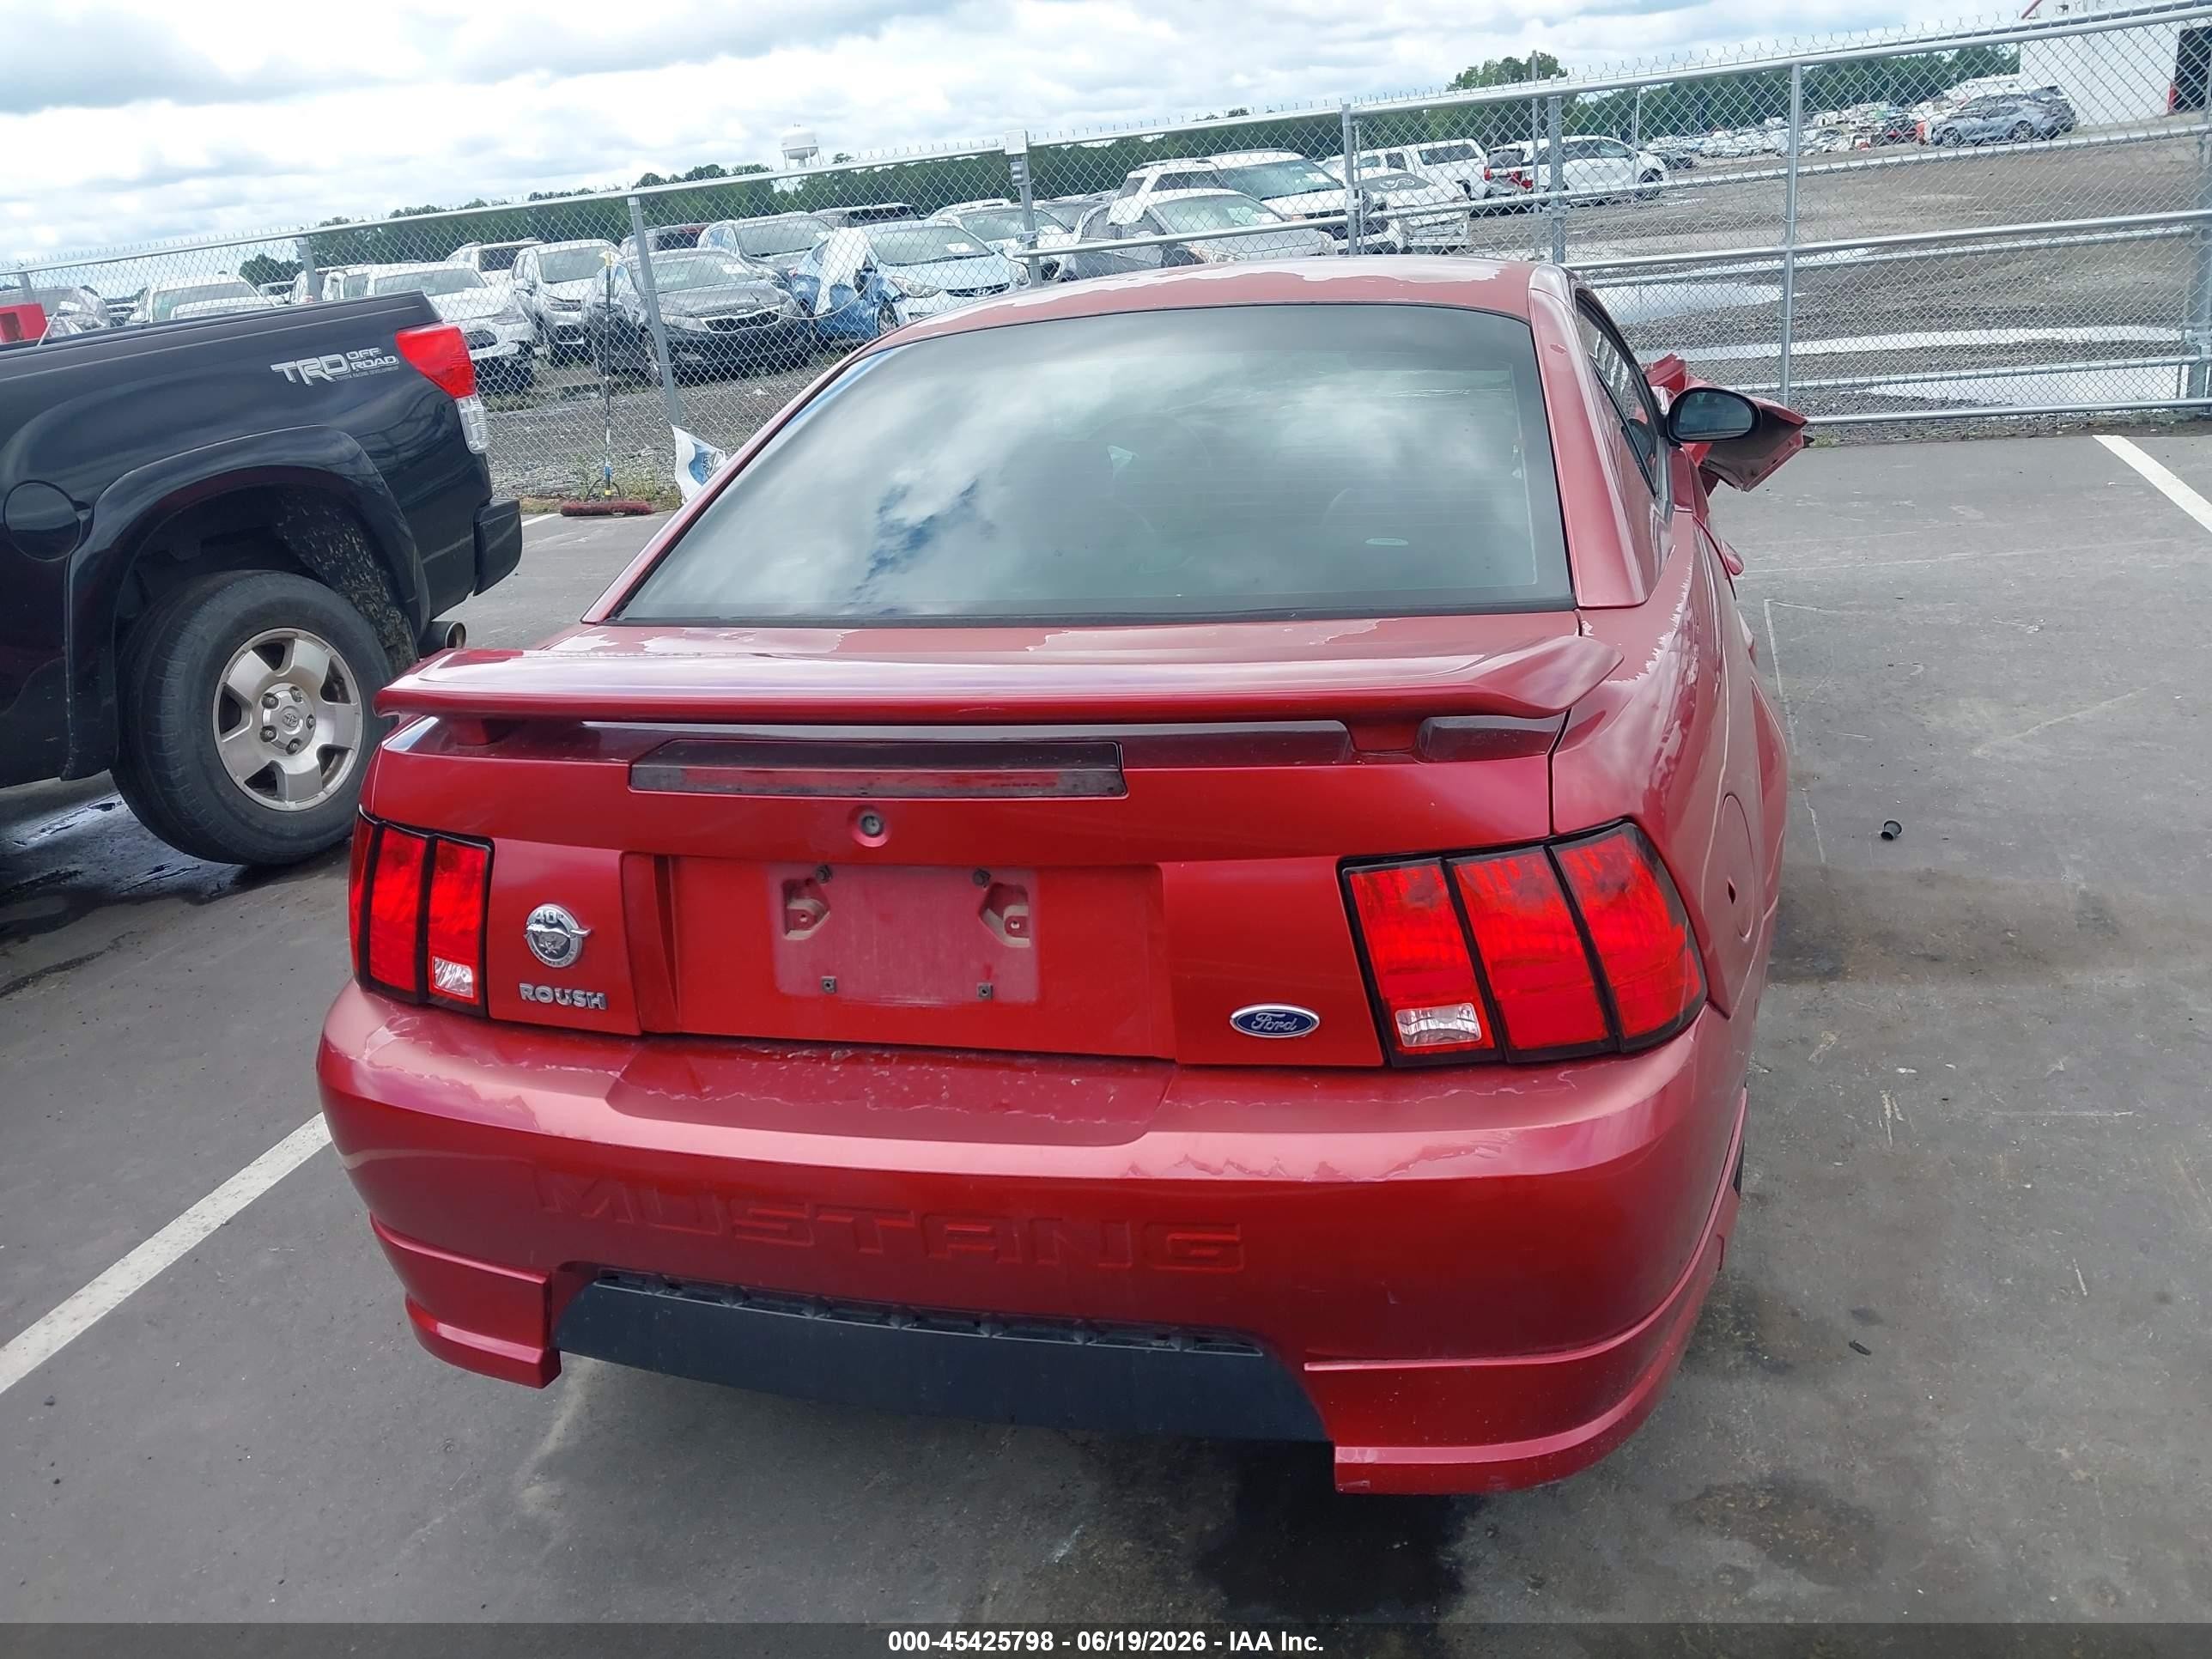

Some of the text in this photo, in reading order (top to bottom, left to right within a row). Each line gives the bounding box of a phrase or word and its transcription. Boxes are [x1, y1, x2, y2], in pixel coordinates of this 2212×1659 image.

[346, 347, 381, 361] OFF
[349, 356, 399, 372] ROAD
[270, 354, 350, 386] TRD
[519, 982, 606, 1010] ROUSH
[1251, 1012, 1297, 1030] Ford
[533, 1175, 1244, 1273] MUSTANG
